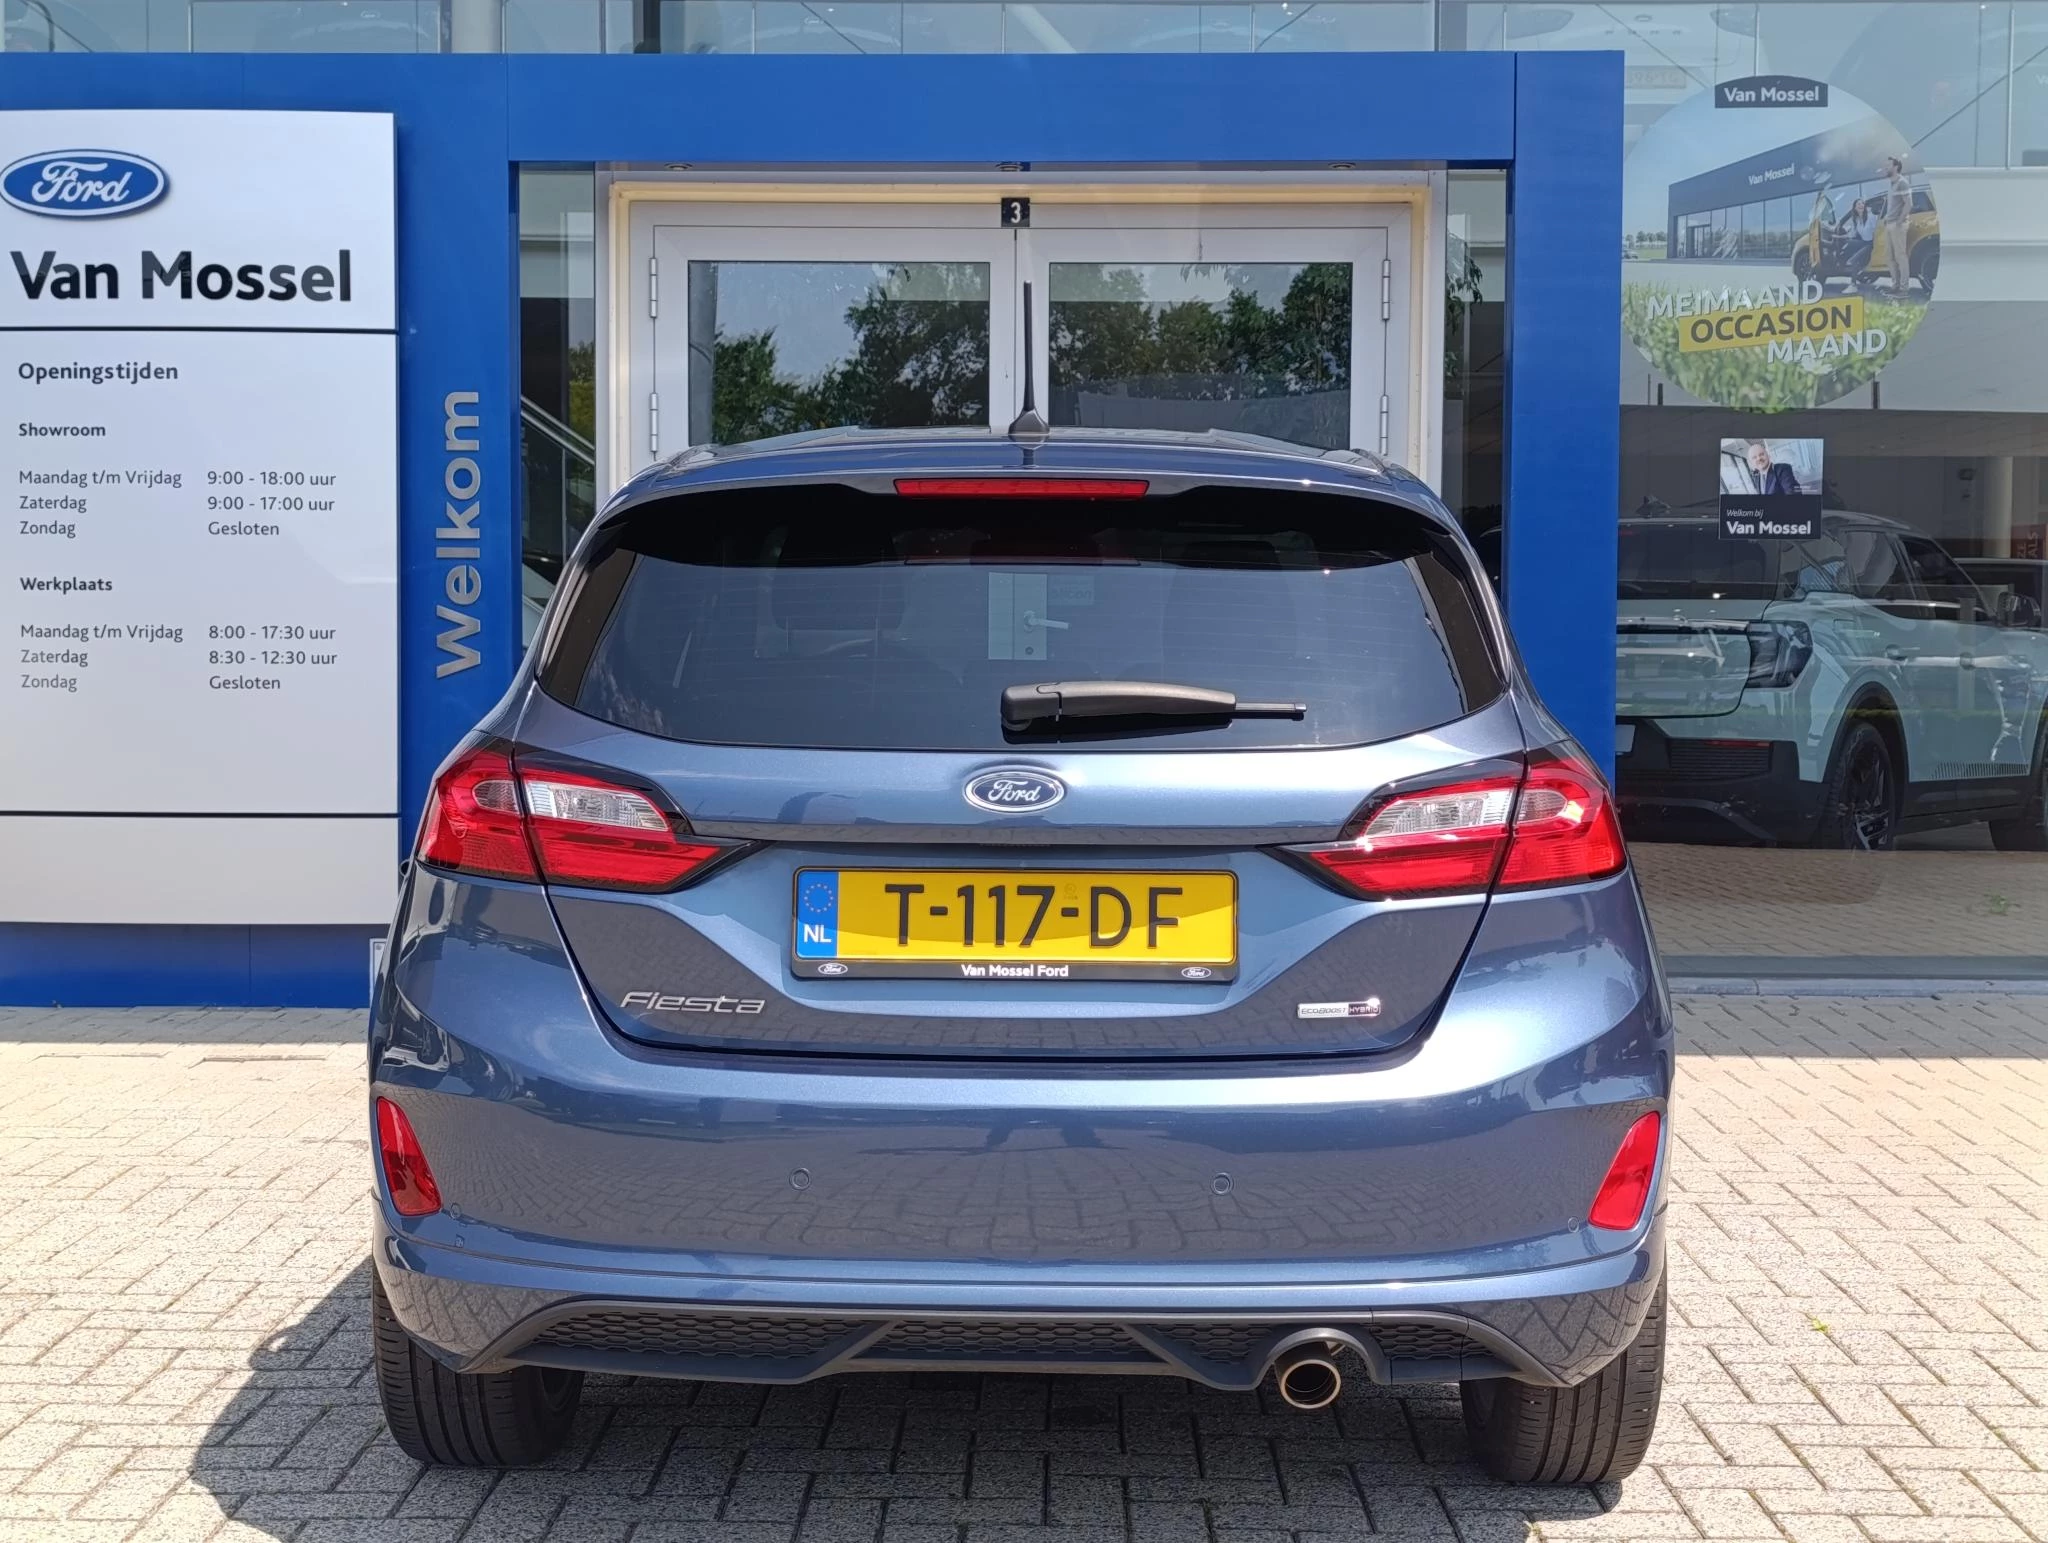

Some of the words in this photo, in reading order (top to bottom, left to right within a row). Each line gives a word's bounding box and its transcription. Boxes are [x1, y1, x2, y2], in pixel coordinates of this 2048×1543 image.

[1724, 87, 1756, 102] Van
[1760, 86, 1819, 101] Mossel
[31, 160, 133, 203] Ford
[1748, 174, 1763, 185] Van
[1764, 162, 1795, 182] Mossel
[1011, 202, 1020, 223] 3
[10, 250, 119, 300] Van
[141, 249, 352, 302] Mossel
[1690, 304, 1853, 344] OCCASION
[1767, 328, 1888, 364] MAAND
[18, 362, 179, 385] Openingstijden
[18, 422, 107, 438] Showroom
[19, 470, 88, 489] Maandag
[92, 469, 121, 485] t/m
[125, 470, 182, 489] Vrijdag
[207, 471, 244, 486] 9:00
[260, 471, 304, 486] 18:00
[309, 475, 337, 486] uur
[19, 495, 87, 514] Zaterdag
[207, 496, 244, 511] 9:00
[260, 497, 304, 511] 17:00
[308, 500, 336, 511] uur
[1726, 509, 1753, 517] Welkom
[1754, 509, 1764, 519] bij
[19, 520, 76, 539] Zondag
[208, 521, 280, 536] Gesloten
[435, 391, 482, 679] Welkom
[1726, 521, 1755, 534] Van
[1759, 520, 1812, 534] Mossel
[19, 577, 113, 593] Werkplaats
[20, 624, 90, 643] Maandag
[93, 624, 122, 639] t/m
[127, 624, 184, 644] Vrijdag
[208, 625, 246, 640] 8:00
[261, 626, 305, 640] 17:30
[309, 629, 337, 640] uur
[20, 649, 89, 668] Zaterdag
[209, 650, 246, 665] 8:30
[261, 651, 306, 665] 12:30
[311, 654, 338, 665] uur
[21, 674, 78, 693] Zondag
[209, 675, 281, 690] Gesloten
[988, 780, 1041, 801] Ford
[884, 883, 1184, 949] T-117-DF
[803, 924, 832, 943] NL
[961, 965, 986, 976] Van
[989, 964, 1033, 977] Mossel
[1037, 966, 1069, 978] Ford
[620, 991, 766, 1014] Fiesta
